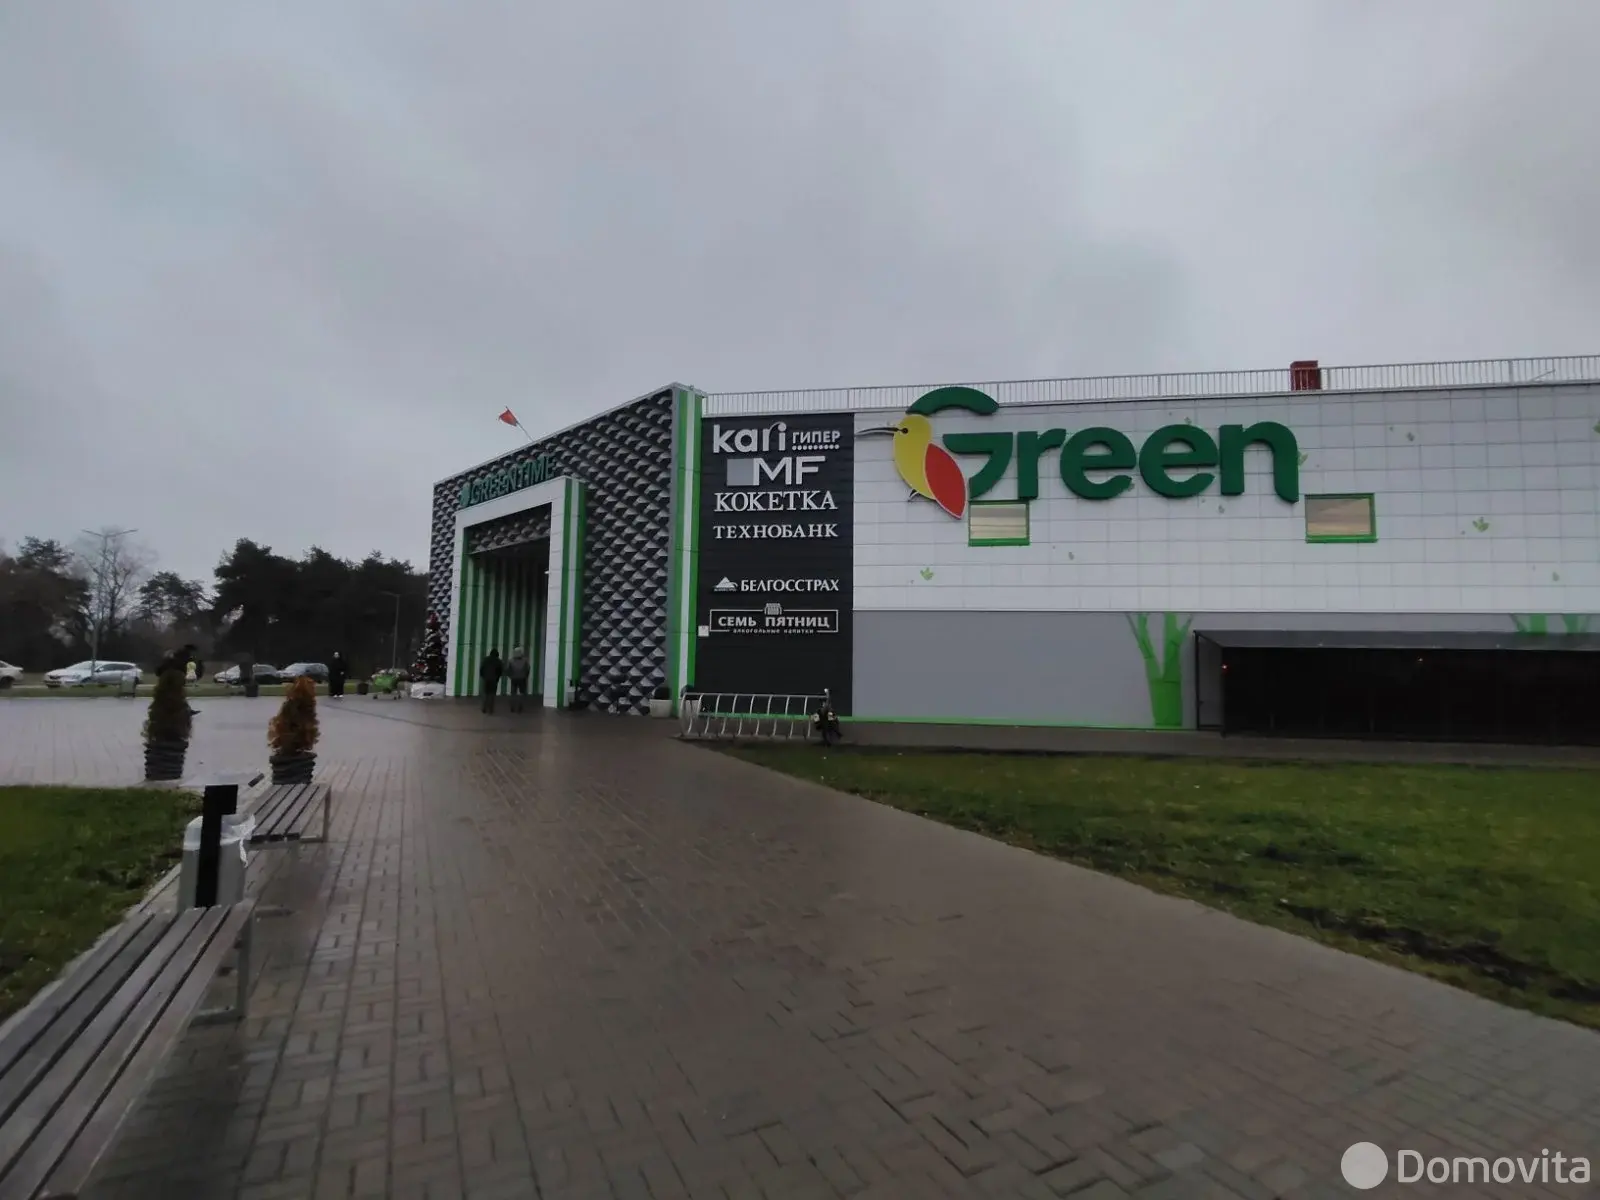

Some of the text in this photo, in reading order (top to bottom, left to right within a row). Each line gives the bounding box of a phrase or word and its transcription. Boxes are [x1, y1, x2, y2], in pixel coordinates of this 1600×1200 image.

[713, 421, 787, 453] kari
[792, 430, 841, 444] ГИПЕР
[904, 386, 1299, 505] Green
[752, 455, 826, 486] MF
[714, 490, 838, 512] КОКЕТКА
[713, 523, 839, 540] ТЕХНОБАНК
[740, 579, 840, 592] БЕЛГОССТРАХ
[718, 616, 830, 628] СЕМЬ ПЯТНИЦ
